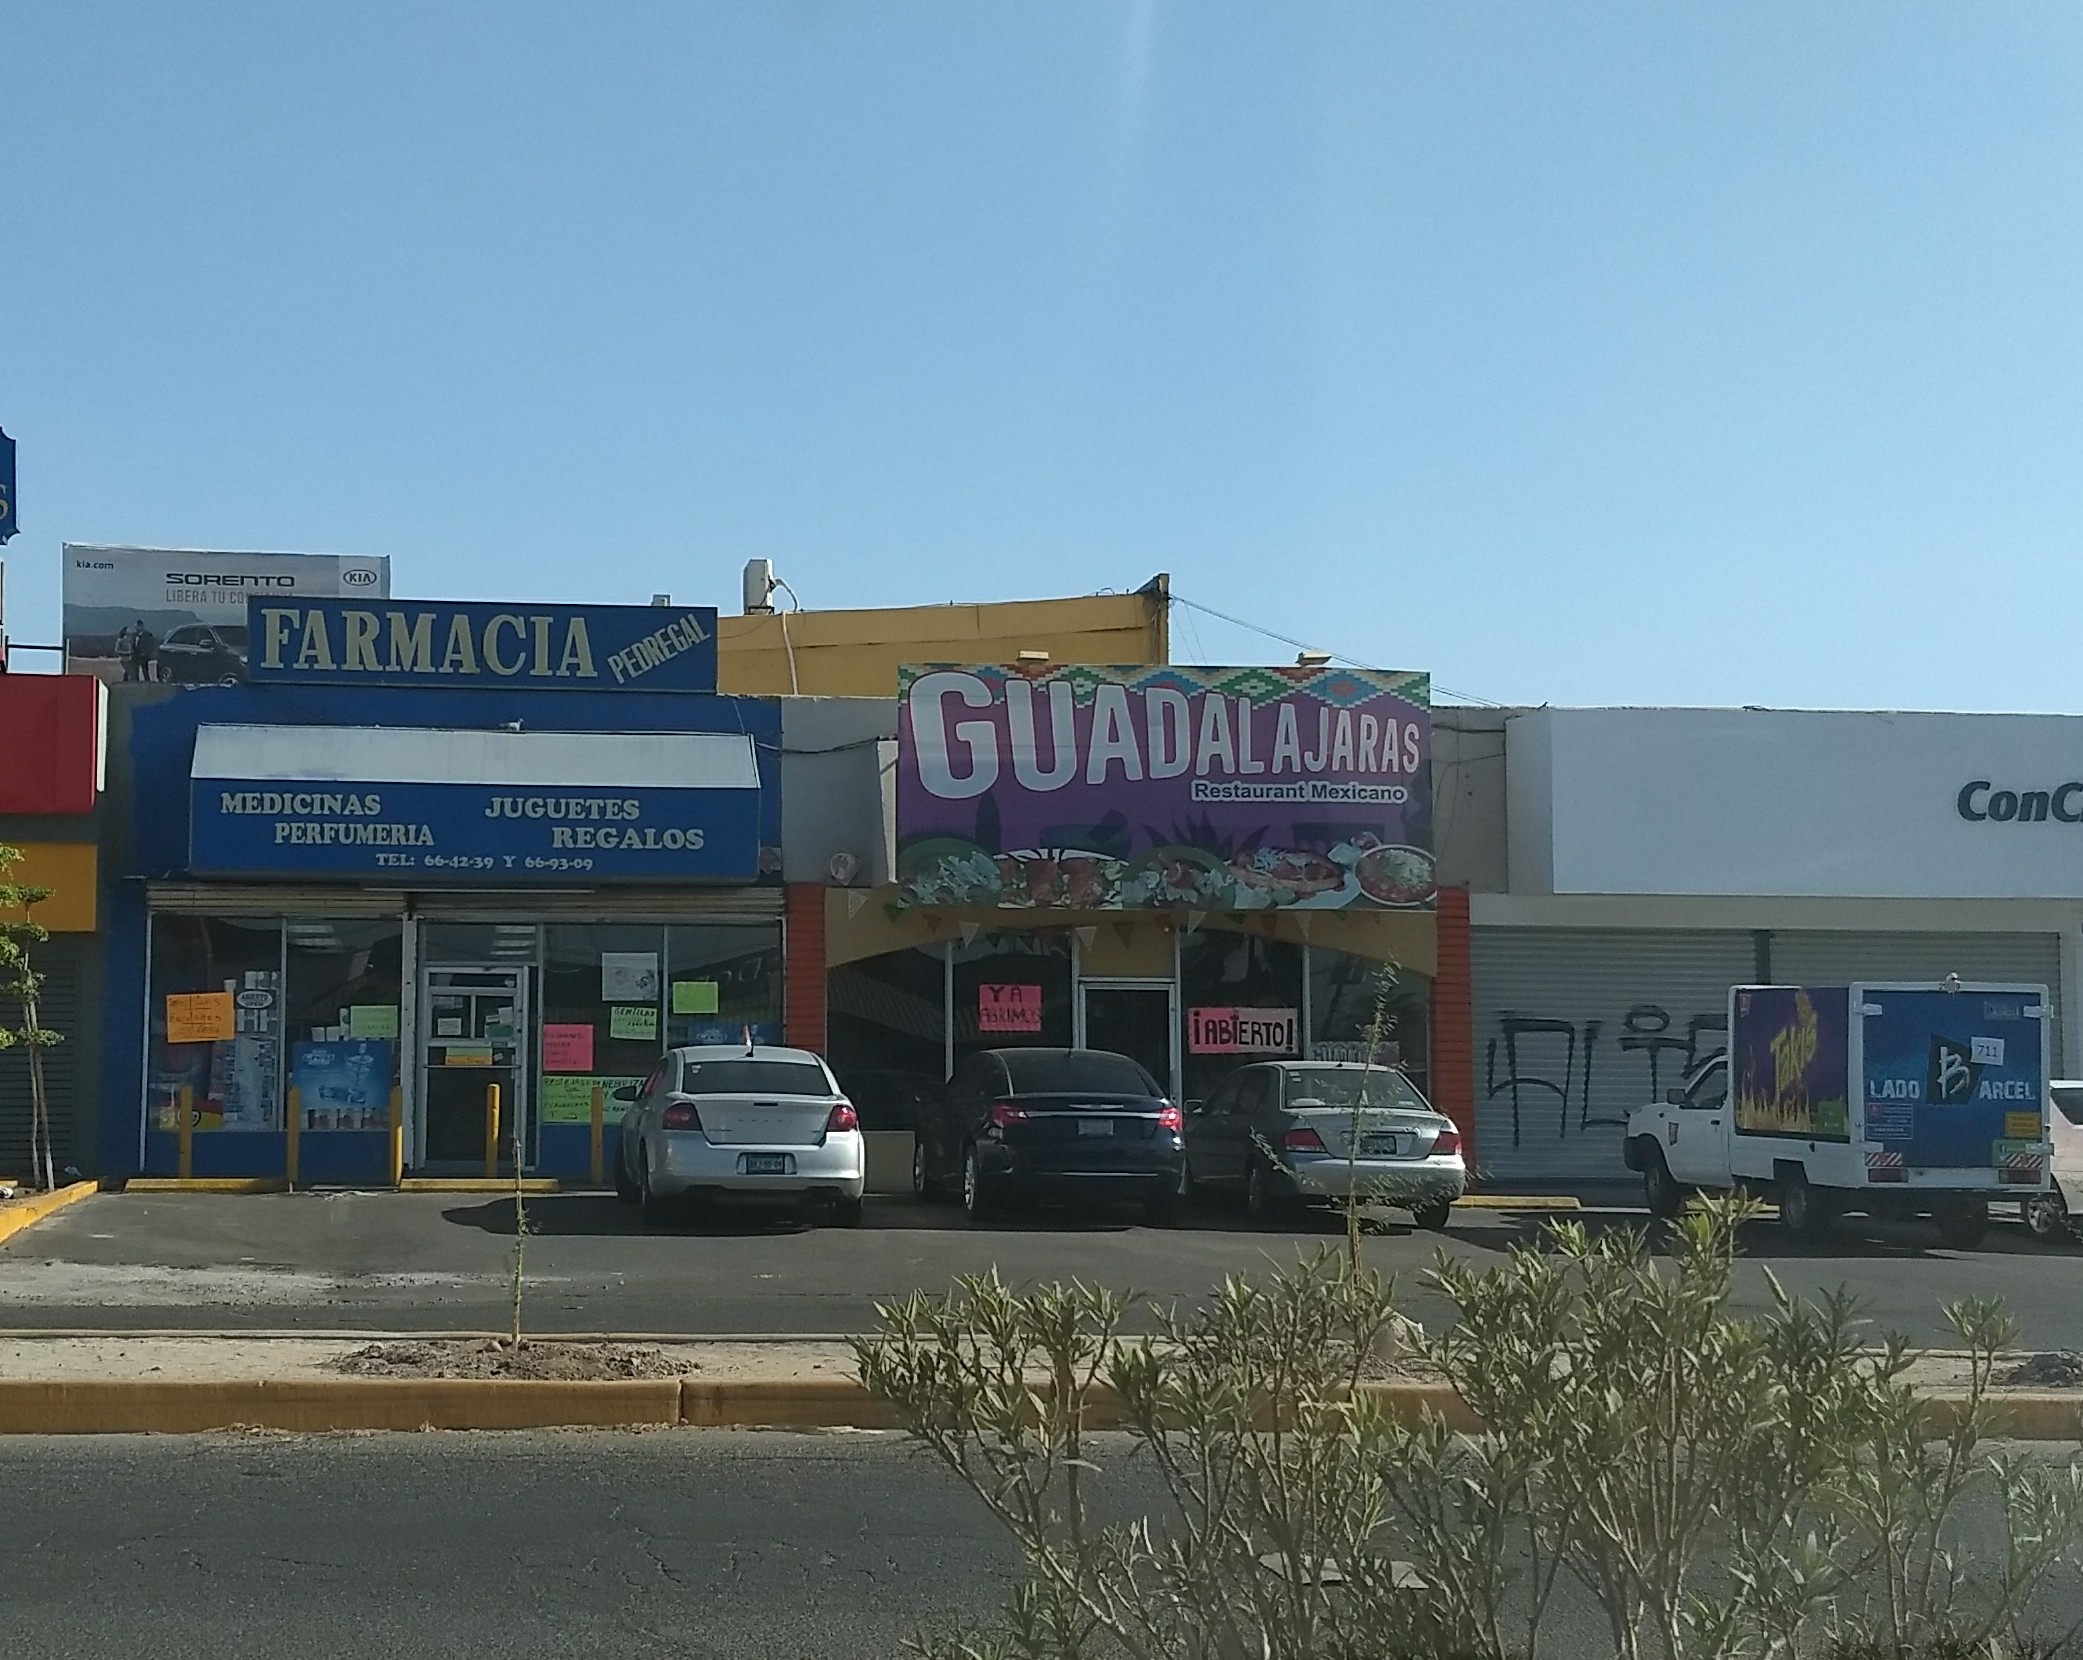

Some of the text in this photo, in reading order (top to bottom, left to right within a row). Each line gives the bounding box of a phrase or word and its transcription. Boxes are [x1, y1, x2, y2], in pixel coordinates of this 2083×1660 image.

[76, 559, 114, 571] kia.com
[166, 573, 296, 587] SORENTO
[348, 572, 371, 583] KIA
[165, 589, 208, 603] LIBERA
[211, 590, 226, 604] TU
[260, 608, 598, 678] FARMACIA
[606, 612, 711, 685] PEDREGAL
[908, 671, 1420, 799] GUADALAJARAS
[1194, 783, 1405, 801] Restaurant Mexicano
[1957, 780, 2083, 823] ConC
[220, 792, 381, 816] MEDICINAS
[485, 797, 640, 820] JUGUETES
[274, 822, 435, 846] PERFUMERIA
[551, 827, 704, 850] REGALOS
[376, 853, 594, 871] TEL: 66-42-39 Y 66-93-09
[988, 985, 1022, 1003] YA
[1978, 1045, 1998, 1058] 711
[1869, 1079, 1920, 1099] LADO
